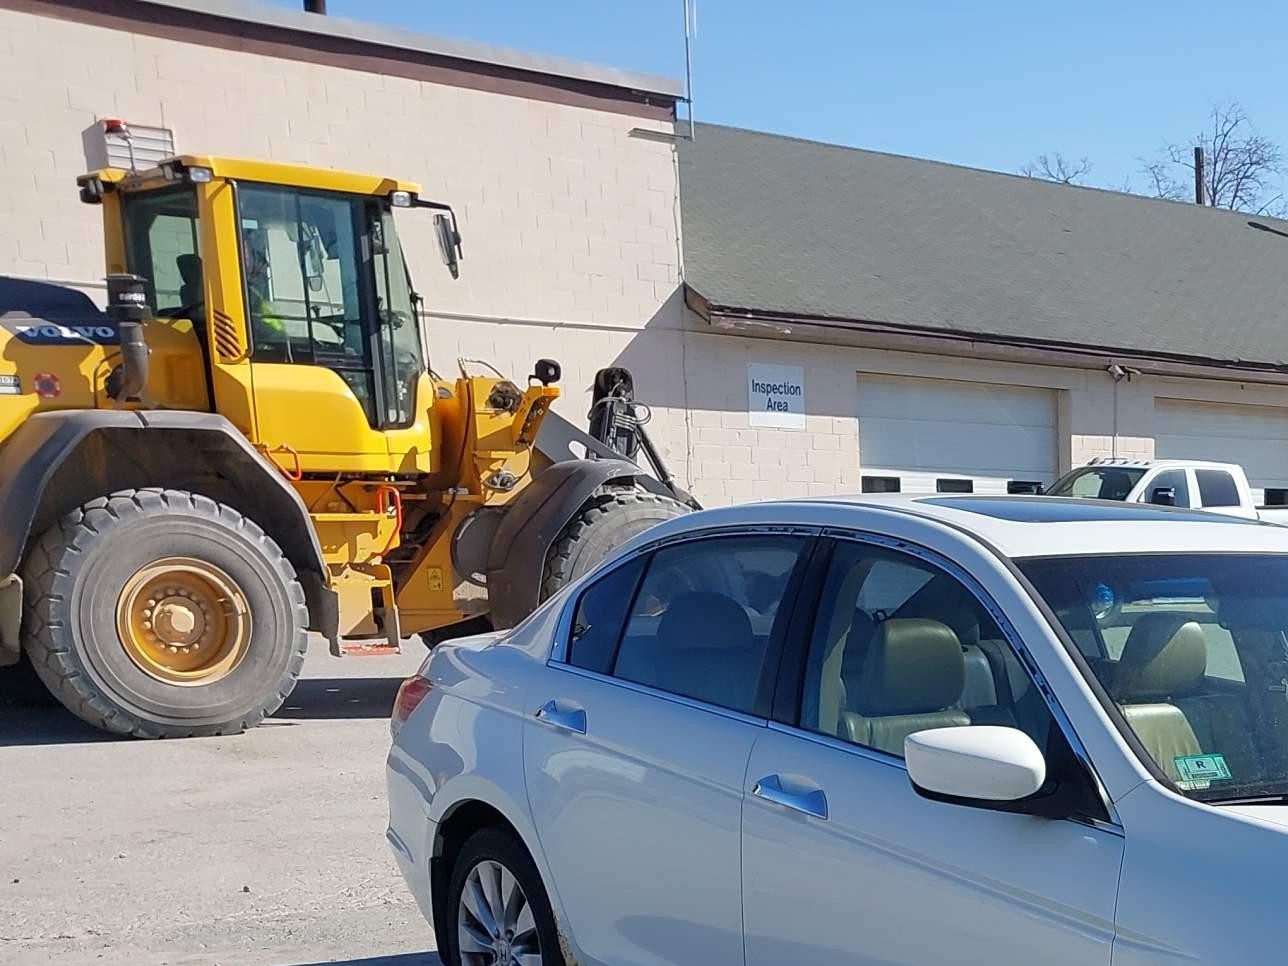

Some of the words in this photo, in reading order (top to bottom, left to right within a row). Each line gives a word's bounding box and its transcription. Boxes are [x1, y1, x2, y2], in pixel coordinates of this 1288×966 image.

[15, 325, 115, 339] VOLVO
[751, 378, 802, 396] Inspection
[766, 397, 789, 412] Area
[1195, 760, 1206, 769] R
